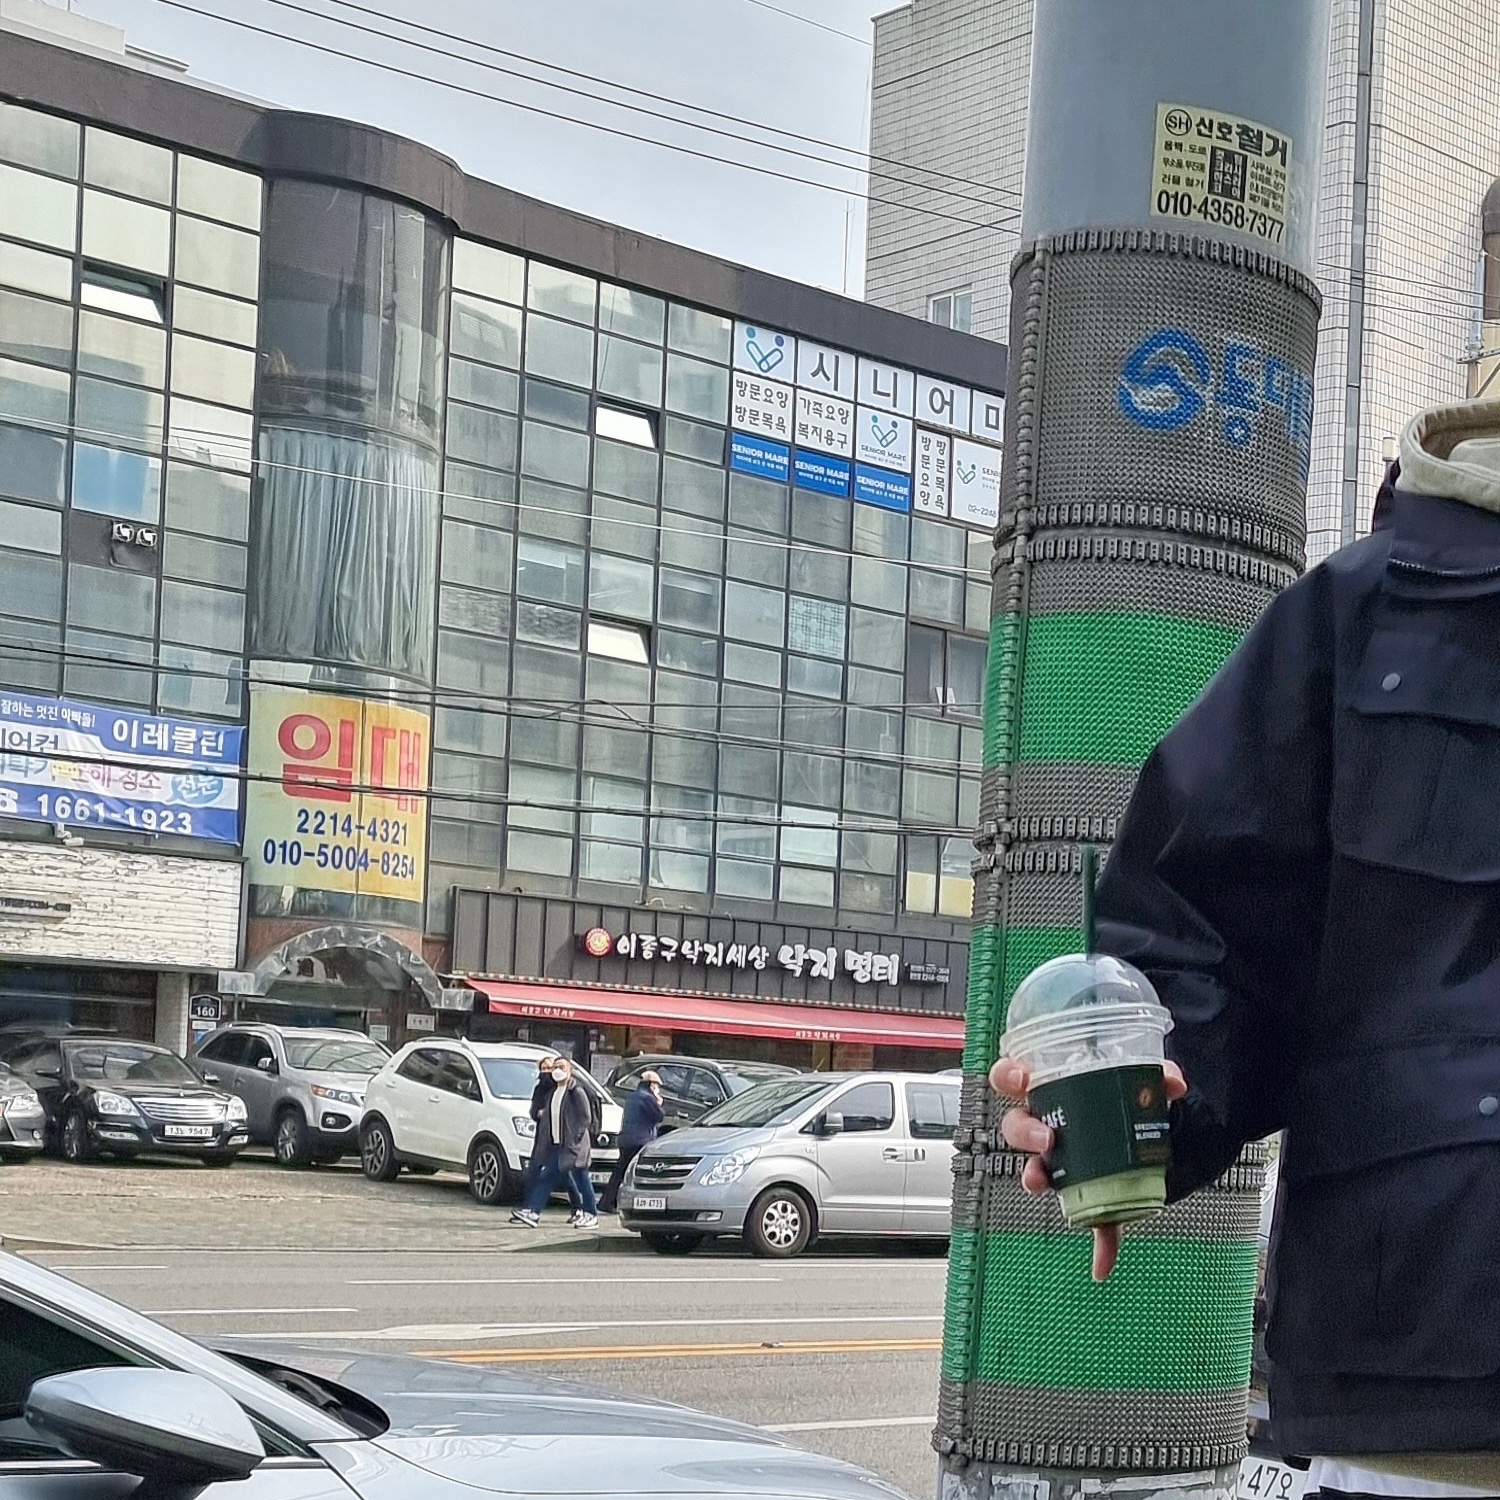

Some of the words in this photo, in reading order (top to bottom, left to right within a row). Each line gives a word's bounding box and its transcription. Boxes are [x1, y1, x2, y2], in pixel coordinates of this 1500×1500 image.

[735, 378, 789, 409] 방문요양
[734, 404, 787, 434] 방문목욕
[799, 396, 850, 425] 가족요양
[798, 422, 848, 449] 복지용구
[732, 443, 763, 458] SENIOR
[764, 451, 789, 466] MARE
[795, 460, 825, 475] SENIOR
[826, 467, 850, 481] MARE
[856, 475, 886, 490] SENIOR
[919, 435, 932, 506] 방문요양
[934, 439, 947, 511] 방문목욕
[36, 704, 59, 721] 멋진
[0, 728, 59, 753] 어컨
[112, 718, 225, 758] 이레클린
[0, 752, 57, 782] 탁기
[278, 714, 421, 815] 임대
[37, 793, 193, 835] 1661-1923
[296, 808, 408, 847] 2214-4321
[263, 838, 415, 881] 010-5004-8254
[196, 1006, 215, 1017] 160
